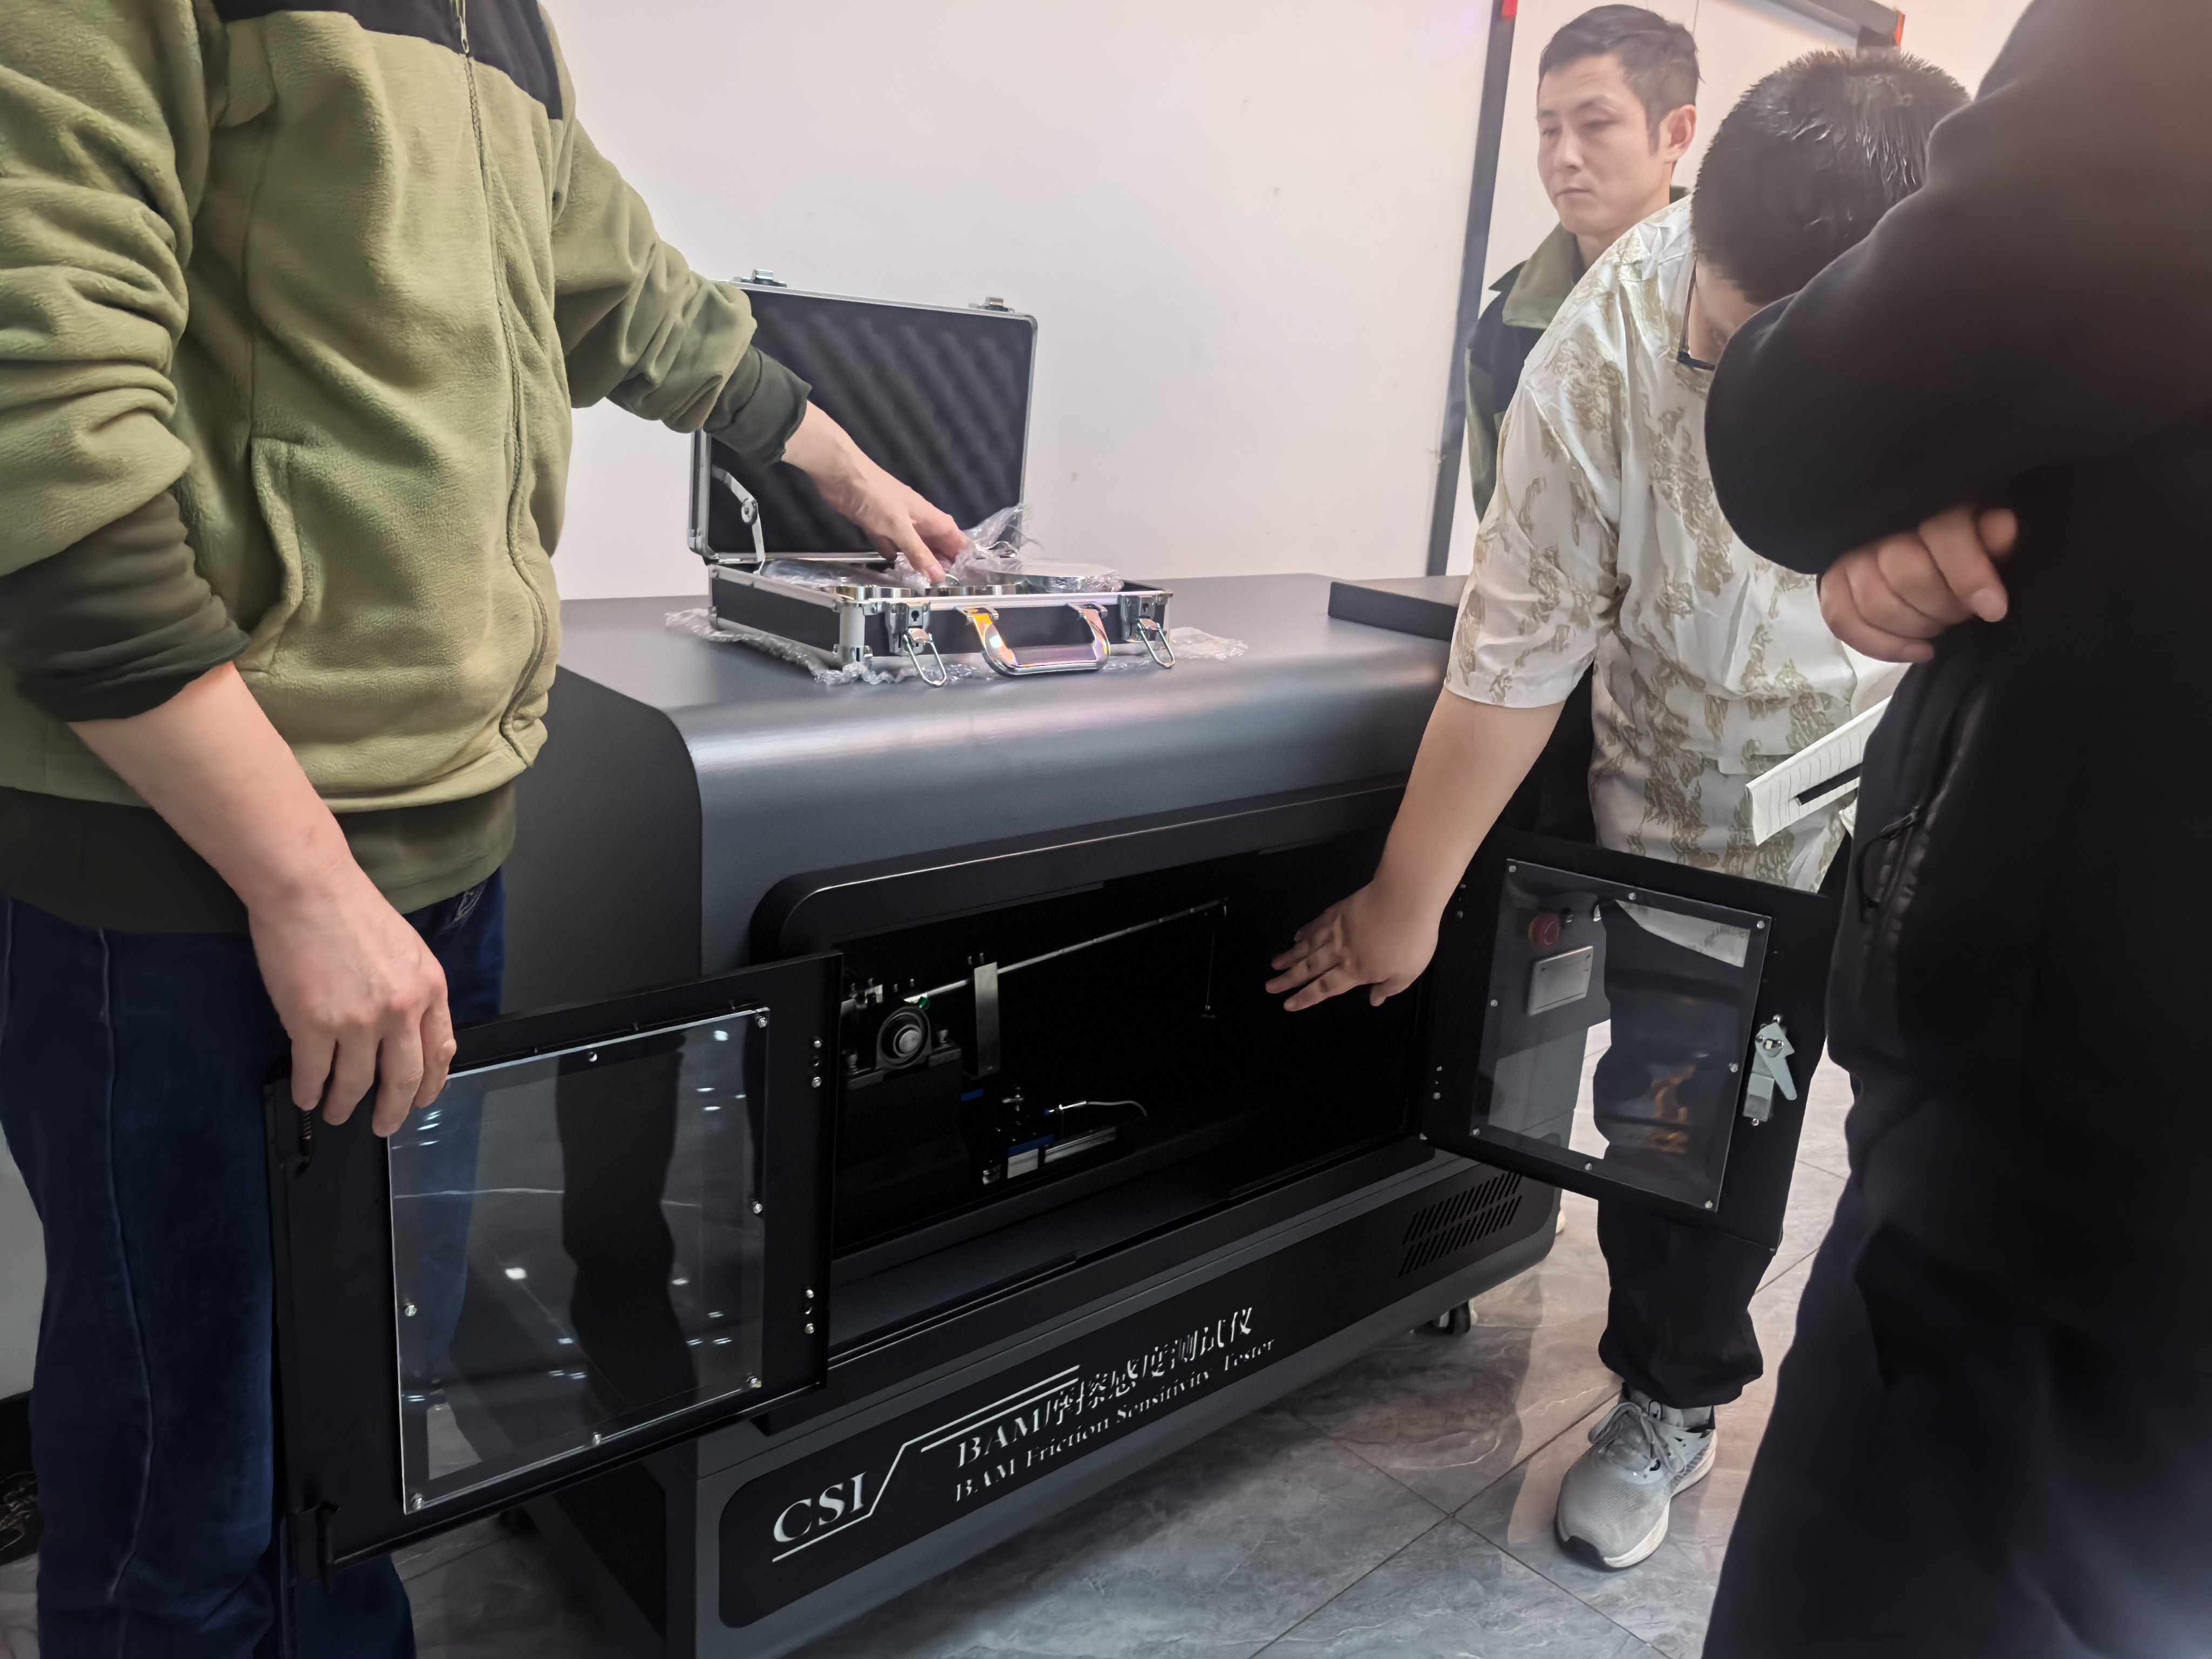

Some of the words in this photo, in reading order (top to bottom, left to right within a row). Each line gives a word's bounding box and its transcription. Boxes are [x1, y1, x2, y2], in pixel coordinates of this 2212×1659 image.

[956, 1458, 1015, 1502] BAM
[1026, 1418, 1109, 1467] Friction
[1116, 1368, 1212, 1424] Sensitivity
[1224, 1339, 1274, 1371] Tester
[773, 1471, 867, 1542] CSI
